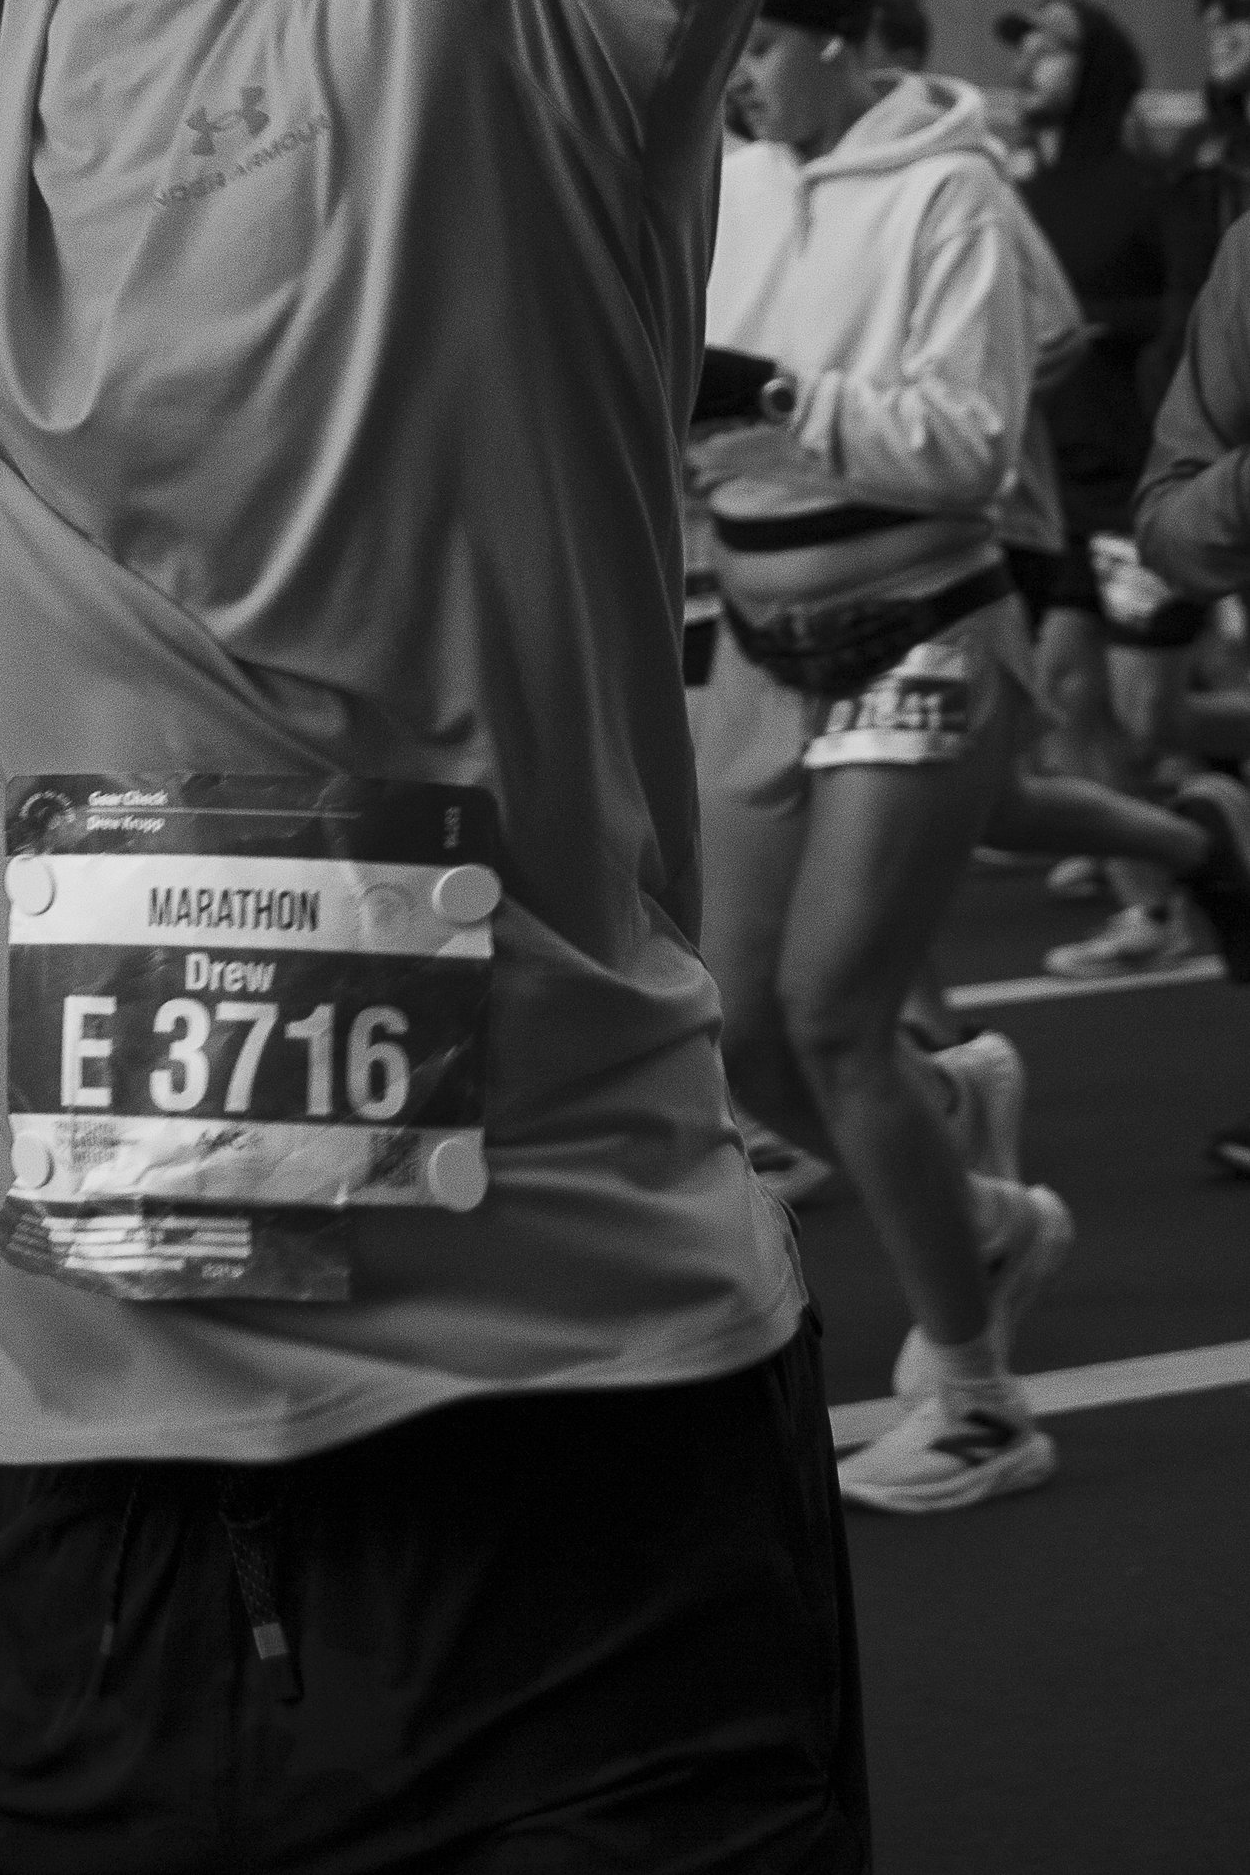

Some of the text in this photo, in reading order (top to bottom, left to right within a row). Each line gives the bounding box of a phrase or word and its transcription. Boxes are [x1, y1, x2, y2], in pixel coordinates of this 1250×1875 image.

[150, 886, 321, 932] MARATHON
[186, 953, 276, 991] Drew
[61, 995, 410, 1119] E 3716
